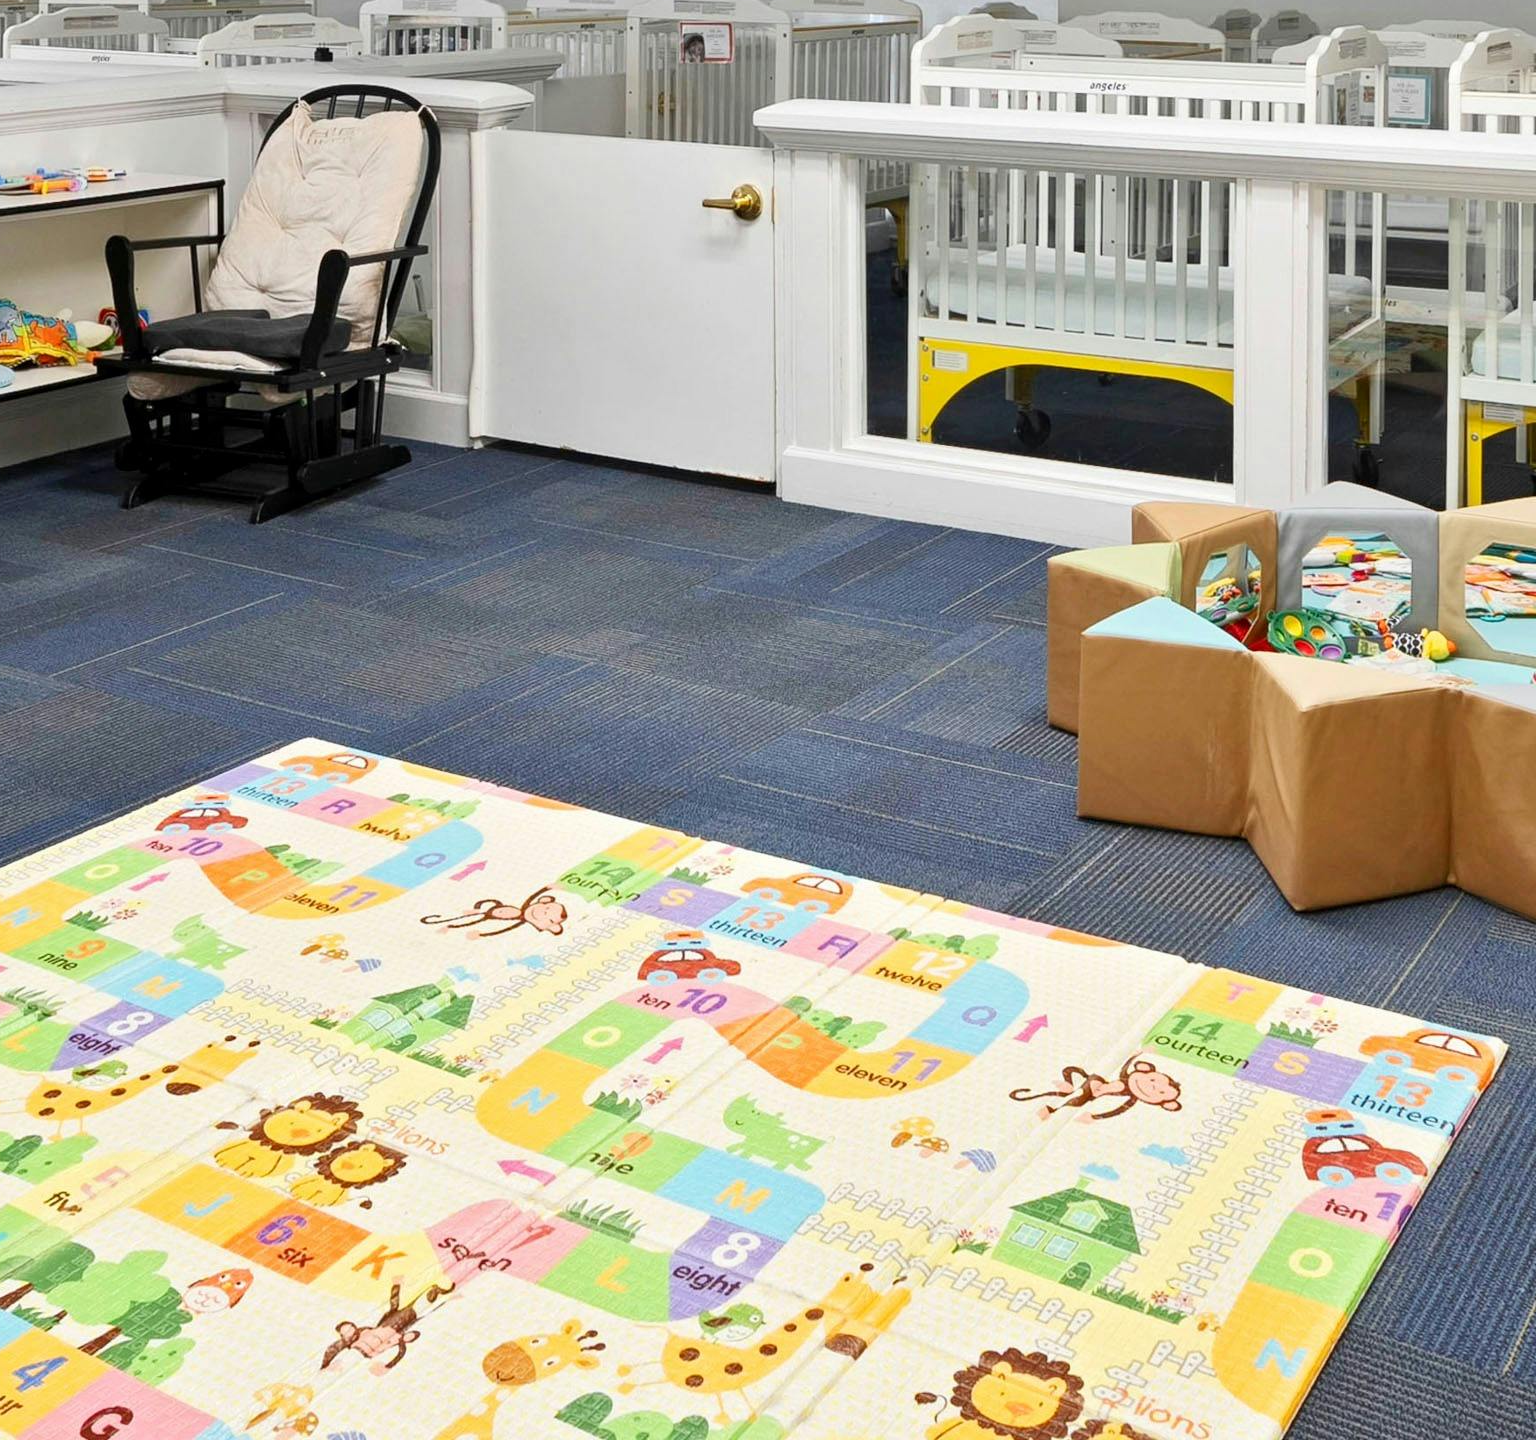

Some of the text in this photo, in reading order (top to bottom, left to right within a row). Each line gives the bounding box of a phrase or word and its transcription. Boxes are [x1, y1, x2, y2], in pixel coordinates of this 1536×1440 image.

[1090, 82, 1127, 91] angeles
[236, 784, 299, 808] thirteen
[263, 775, 308, 796] 13
[330, 798, 358, 814] R
[178, 836, 224, 857] 10
[414, 852, 448, 869] Q
[228, 870, 269, 884] P
[329, 885, 379, 909] 11
[659, 888, 695, 907] S
[733, 905, 786, 931] 13
[708, 918, 788, 949] thirteen
[37, 951, 78, 972] nine
[66, 939, 109, 961] 9
[910, 950, 964, 978] 12
[874, 966, 944, 993] twelve
[1226, 981, 1256, 1004] T
[637, 992, 671, 1011] ten
[677, 988, 728, 1015] 10
[104, 1011, 156, 1036] 8
[963, 1006, 999, 1027] Q
[1169, 1013, 1224, 1043] 14
[67, 1029, 122, 1057] eight
[1154, 1035, 1250, 1069] ourteen
[835, 1061, 908, 1092] eleven
[888, 1050, 944, 1082] 11
[1273, 1051, 1311, 1076] S
[510, 1087, 560, 1116] N
[1374, 1073, 1435, 1109] 13
[1351, 1092, 1457, 1138] thirteen
[394, 1124, 450, 1155] lions
[184, 1193, 234, 1218] J
[714, 1180, 772, 1215] M
[1325, 1197, 1369, 1223] ten
[255, 1214, 310, 1245] 6
[277, 1246, 312, 1268] six
[351, 1244, 406, 1280] K
[711, 1232, 762, 1268] 8
[596, 1256, 630, 1294] L
[672, 1265, 742, 1297] eight
[1254, 1339, 1311, 1378] N
[12, 1356, 70, 1392] 4
[79, 1406, 135, 1440] G
[1134, 1395, 1213, 1440] lions
